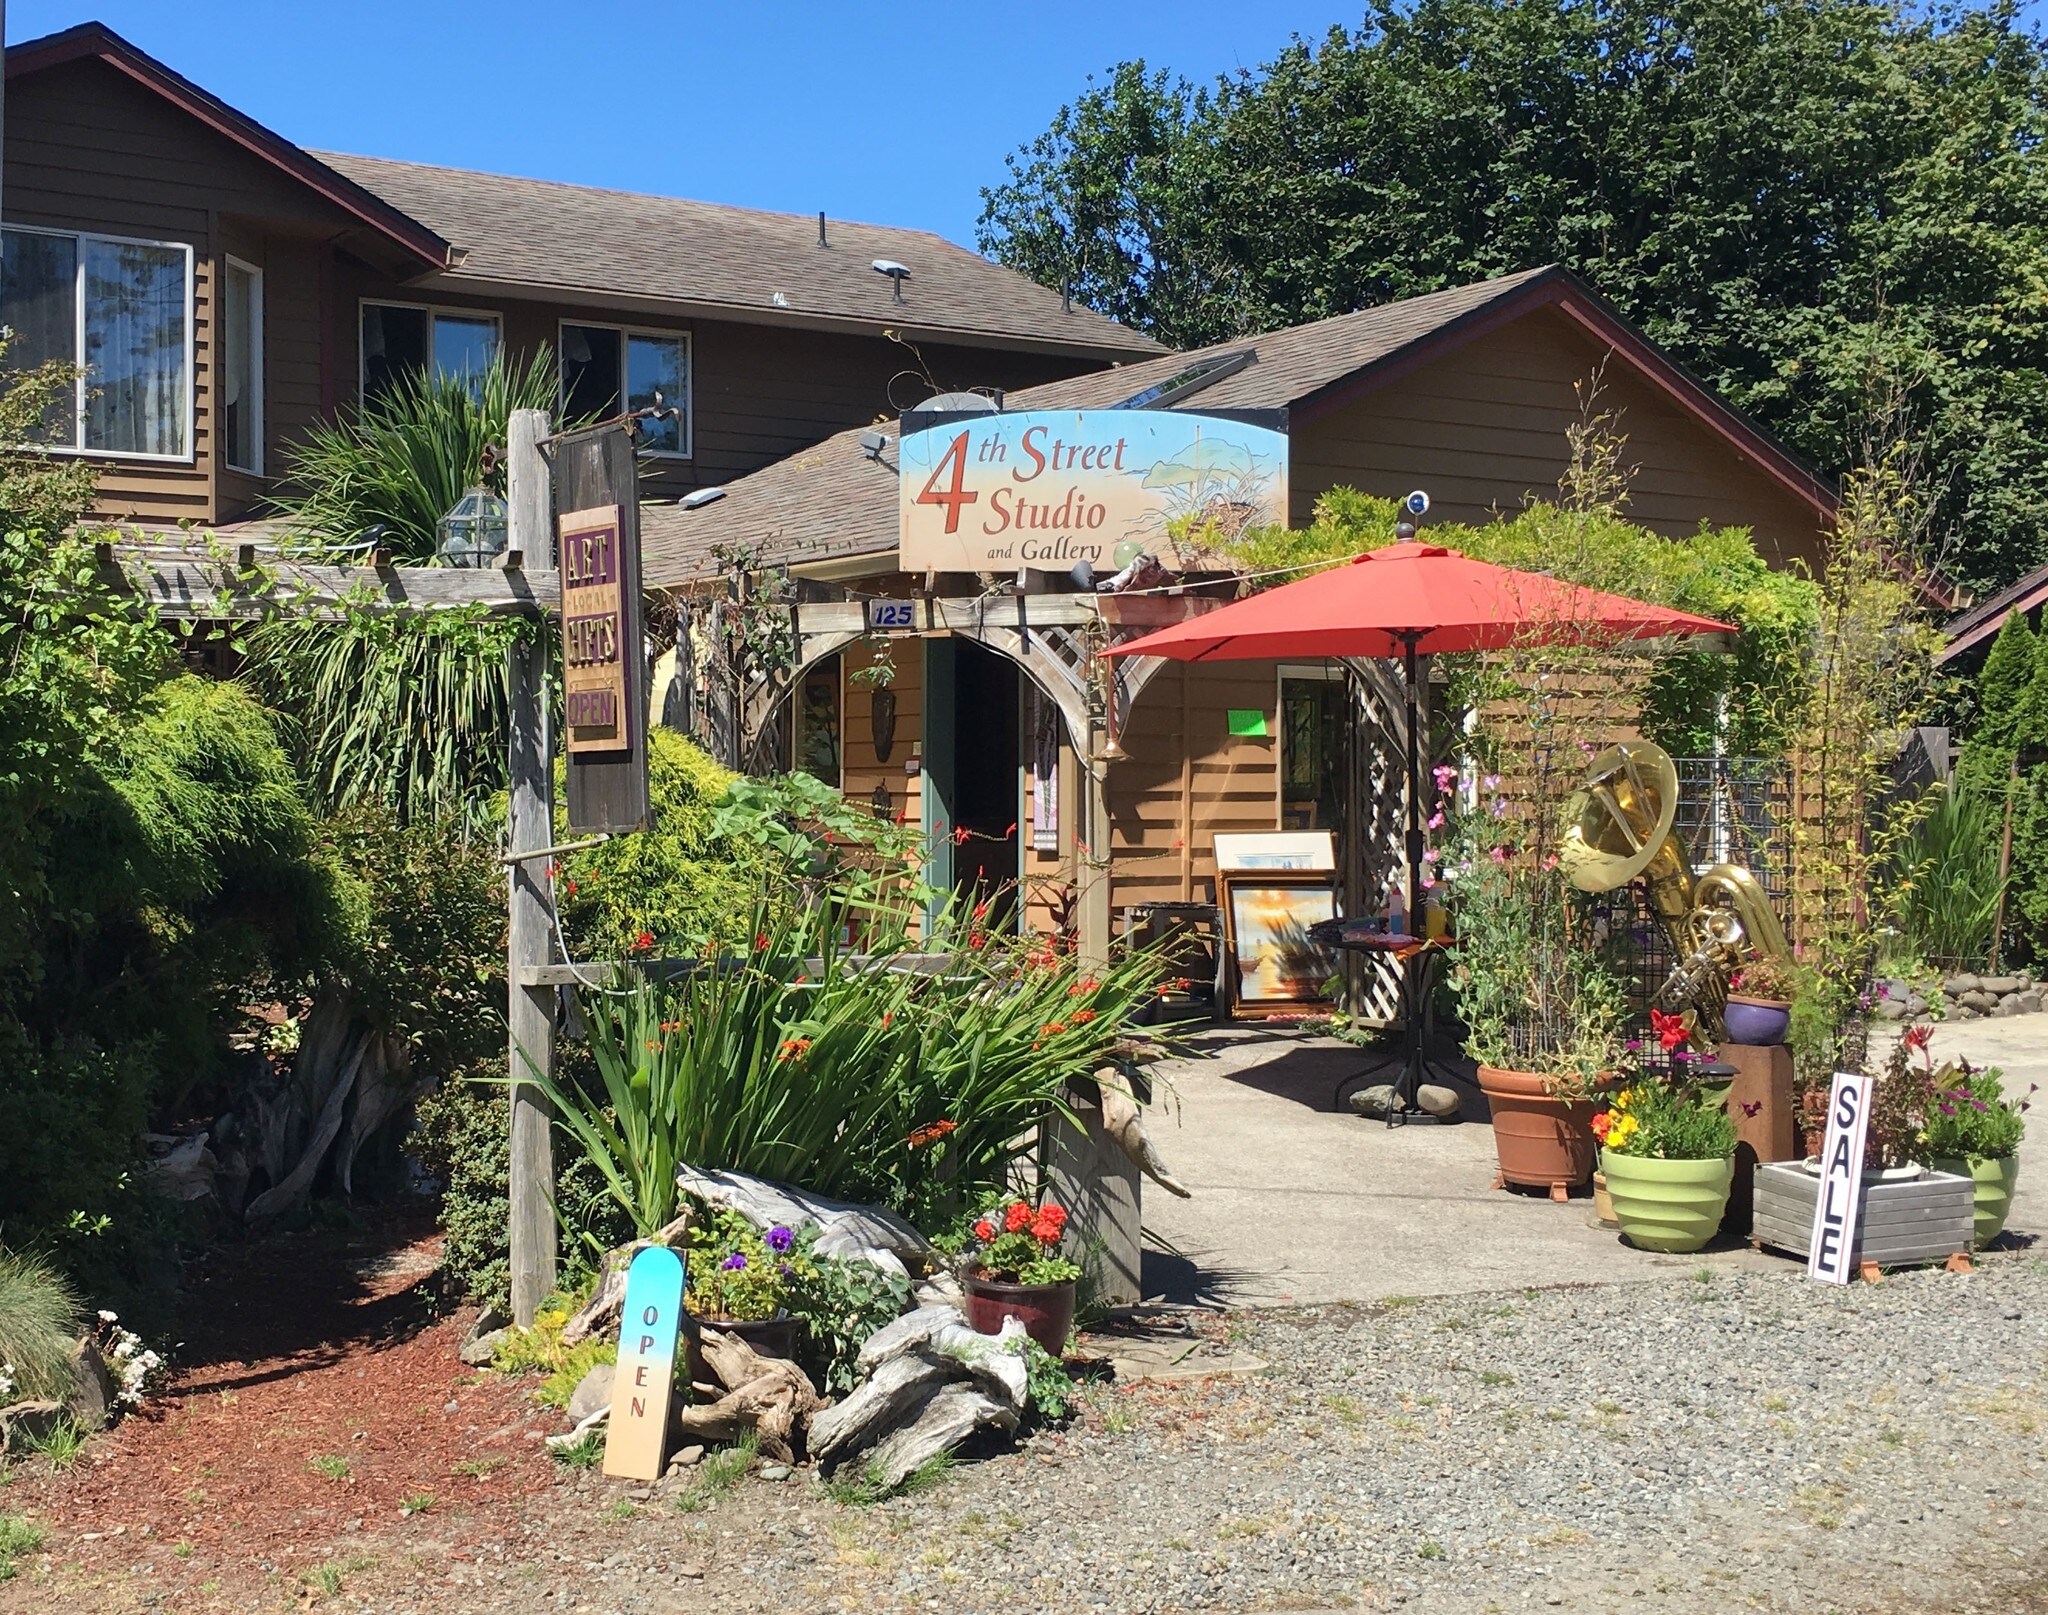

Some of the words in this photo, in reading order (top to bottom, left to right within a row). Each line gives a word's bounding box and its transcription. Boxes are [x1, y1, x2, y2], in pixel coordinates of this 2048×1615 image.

[1012, 426, 1128, 482] Street
[982, 486, 1106, 535] Studio
[567, 534, 608, 582] ART
[987, 541, 1014, 559] and
[1021, 536, 1102, 564] Gallery
[568, 615, 616, 662] GIFTS
[876, 606, 912, 625] 125
[568, 692, 612, 726] OPEN
[1817, 1085, 1858, 1273] SALE
[630, 1305, 658, 1418] OPEN
